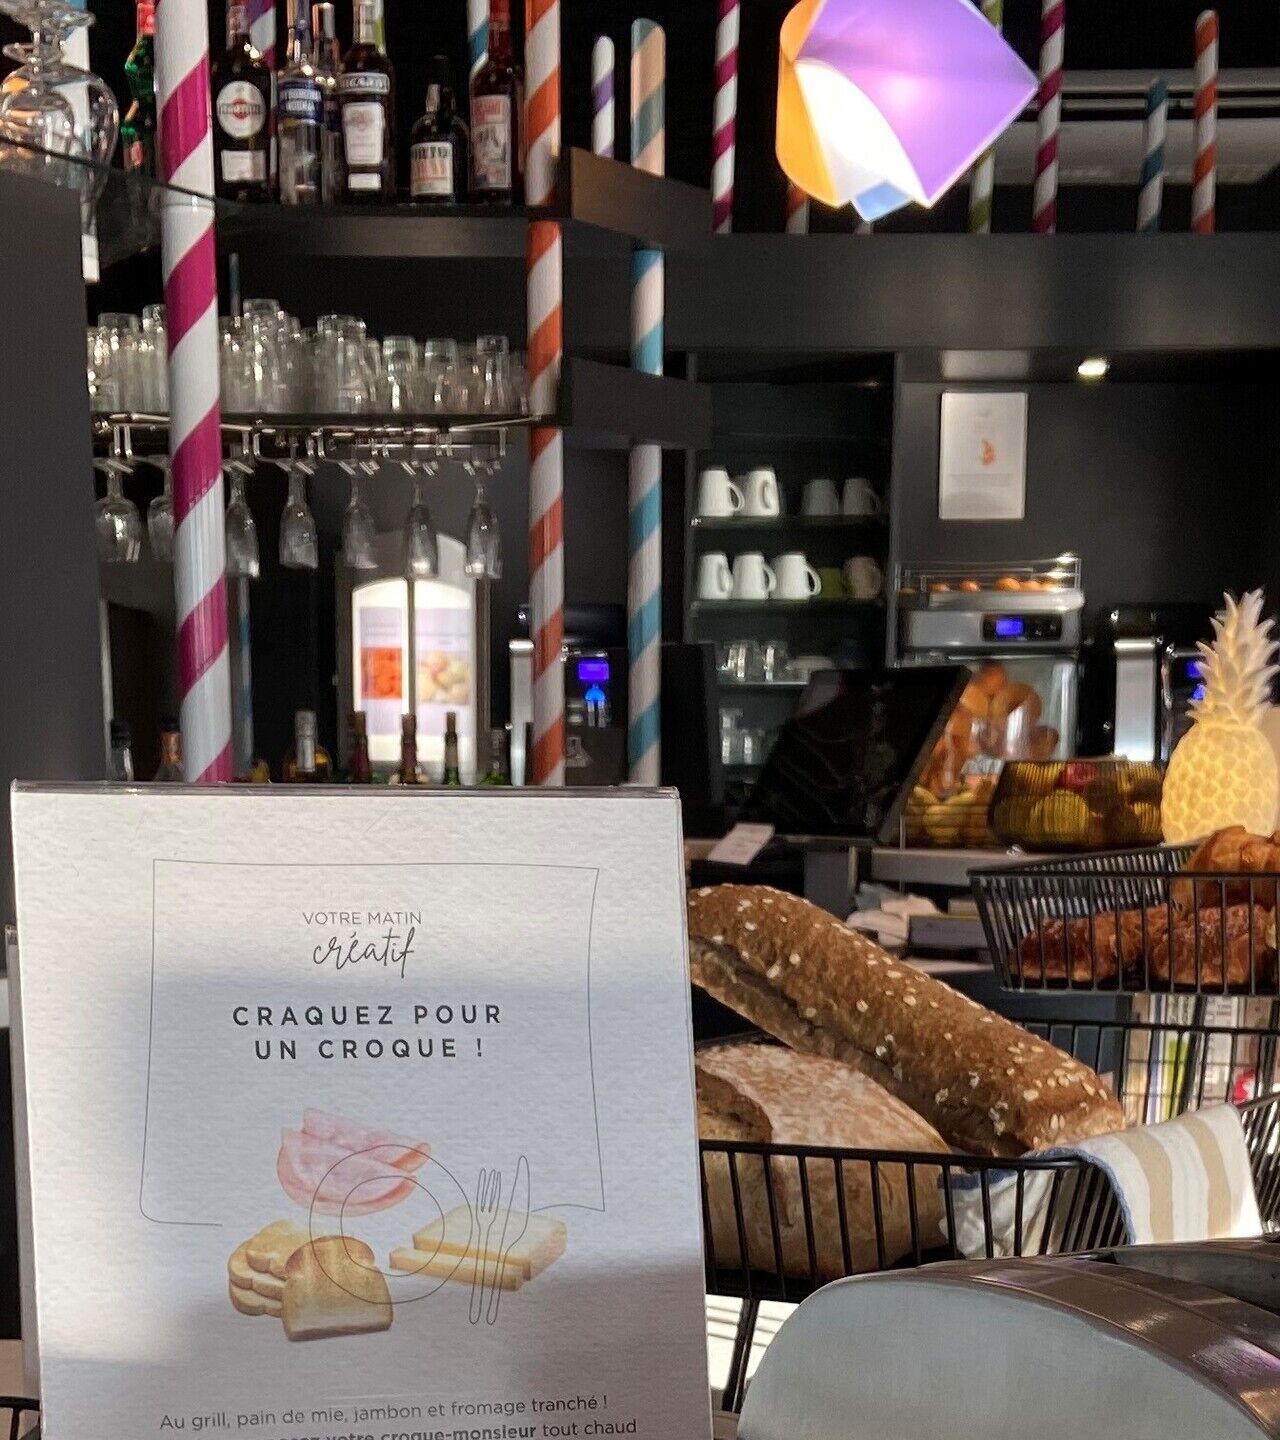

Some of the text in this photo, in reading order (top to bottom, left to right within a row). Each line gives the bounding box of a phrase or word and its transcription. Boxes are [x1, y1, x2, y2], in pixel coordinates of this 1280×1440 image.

[302, 911, 422, 924] VOTRE MATIN
[313, 926, 416, 979] créatif
[232, 1004, 501, 1026] CRAQUEZ POUR
[255, 1038, 483, 1060] UN CROQUE !
[160, 1395, 608, 1431] Au grill, pain de mie, jambon et fromage tranché !
[542, 1422, 578, 1437] tout
[584, 1418, 637, 1435] chaud
